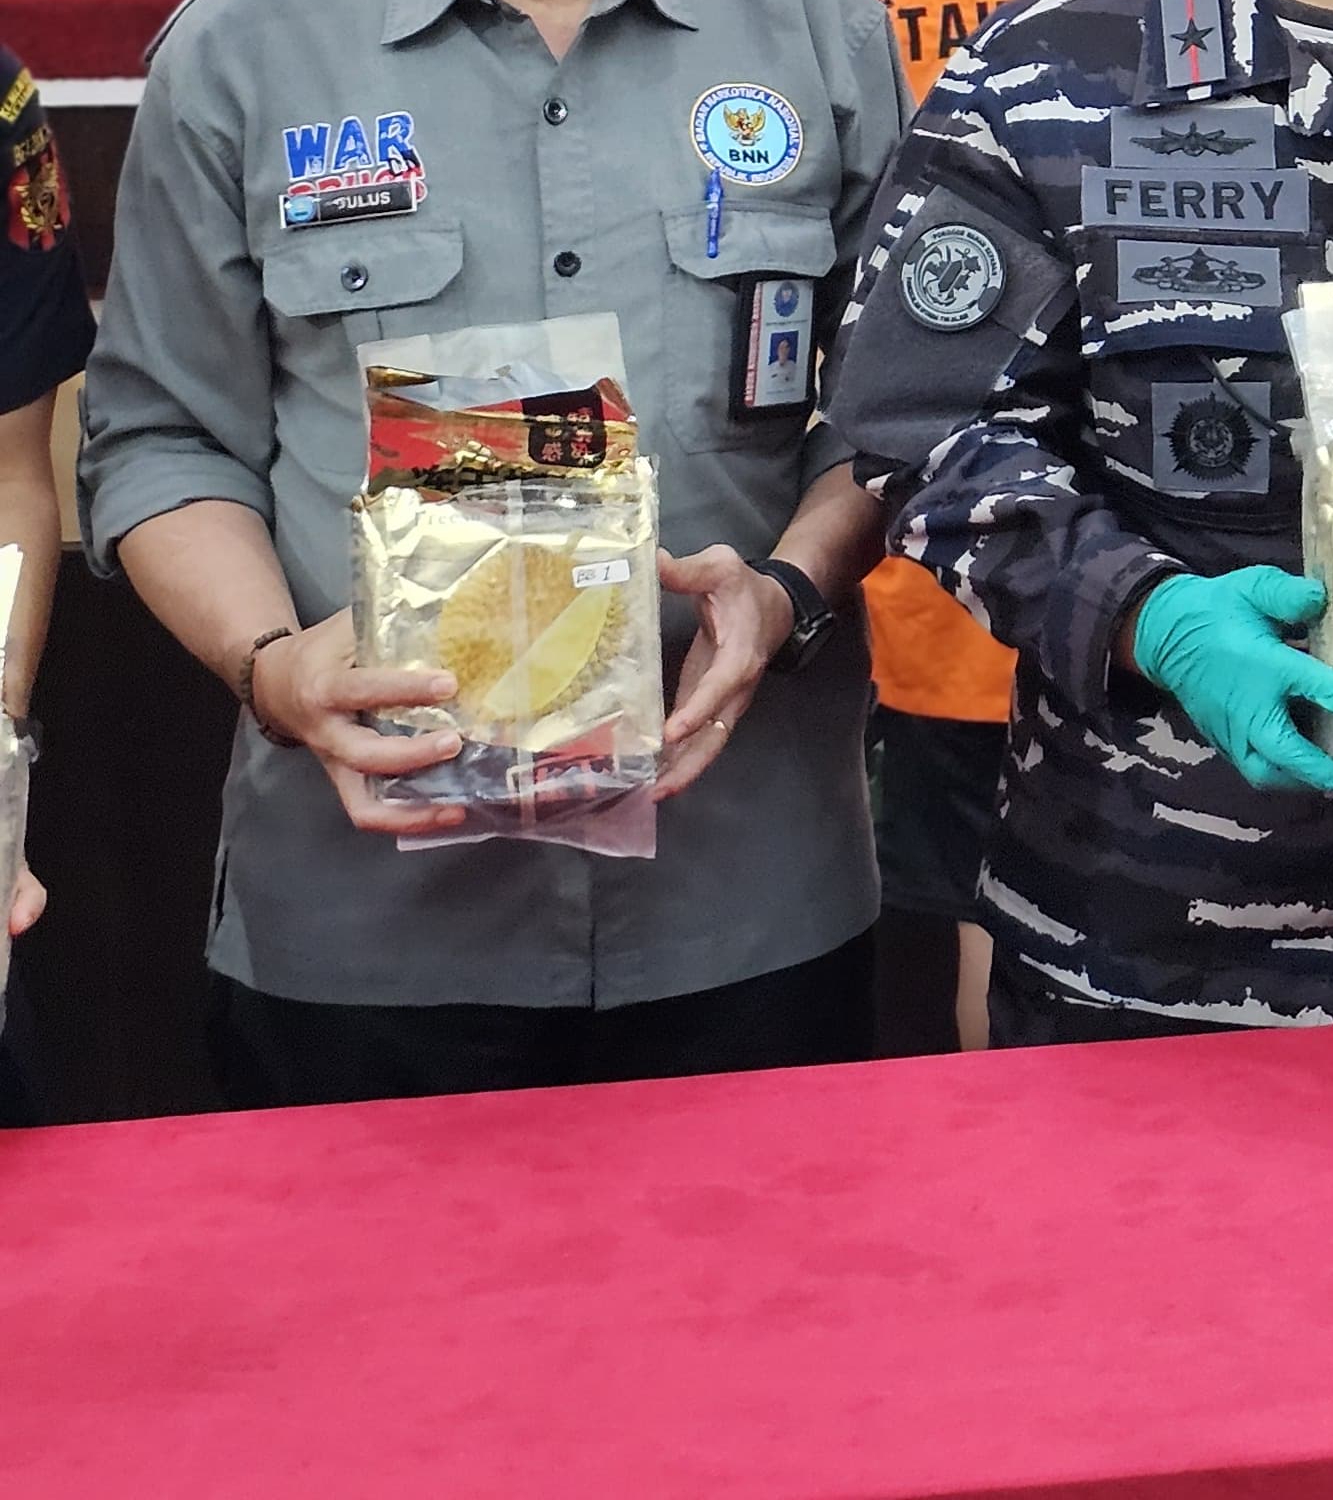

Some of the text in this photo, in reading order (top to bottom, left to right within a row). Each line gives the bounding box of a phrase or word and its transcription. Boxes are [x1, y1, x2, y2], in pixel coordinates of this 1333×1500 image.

[283, 111, 421, 182] WAR
[728, 148, 770, 165] BNN
[1105, 178, 1285, 221] FERRY
